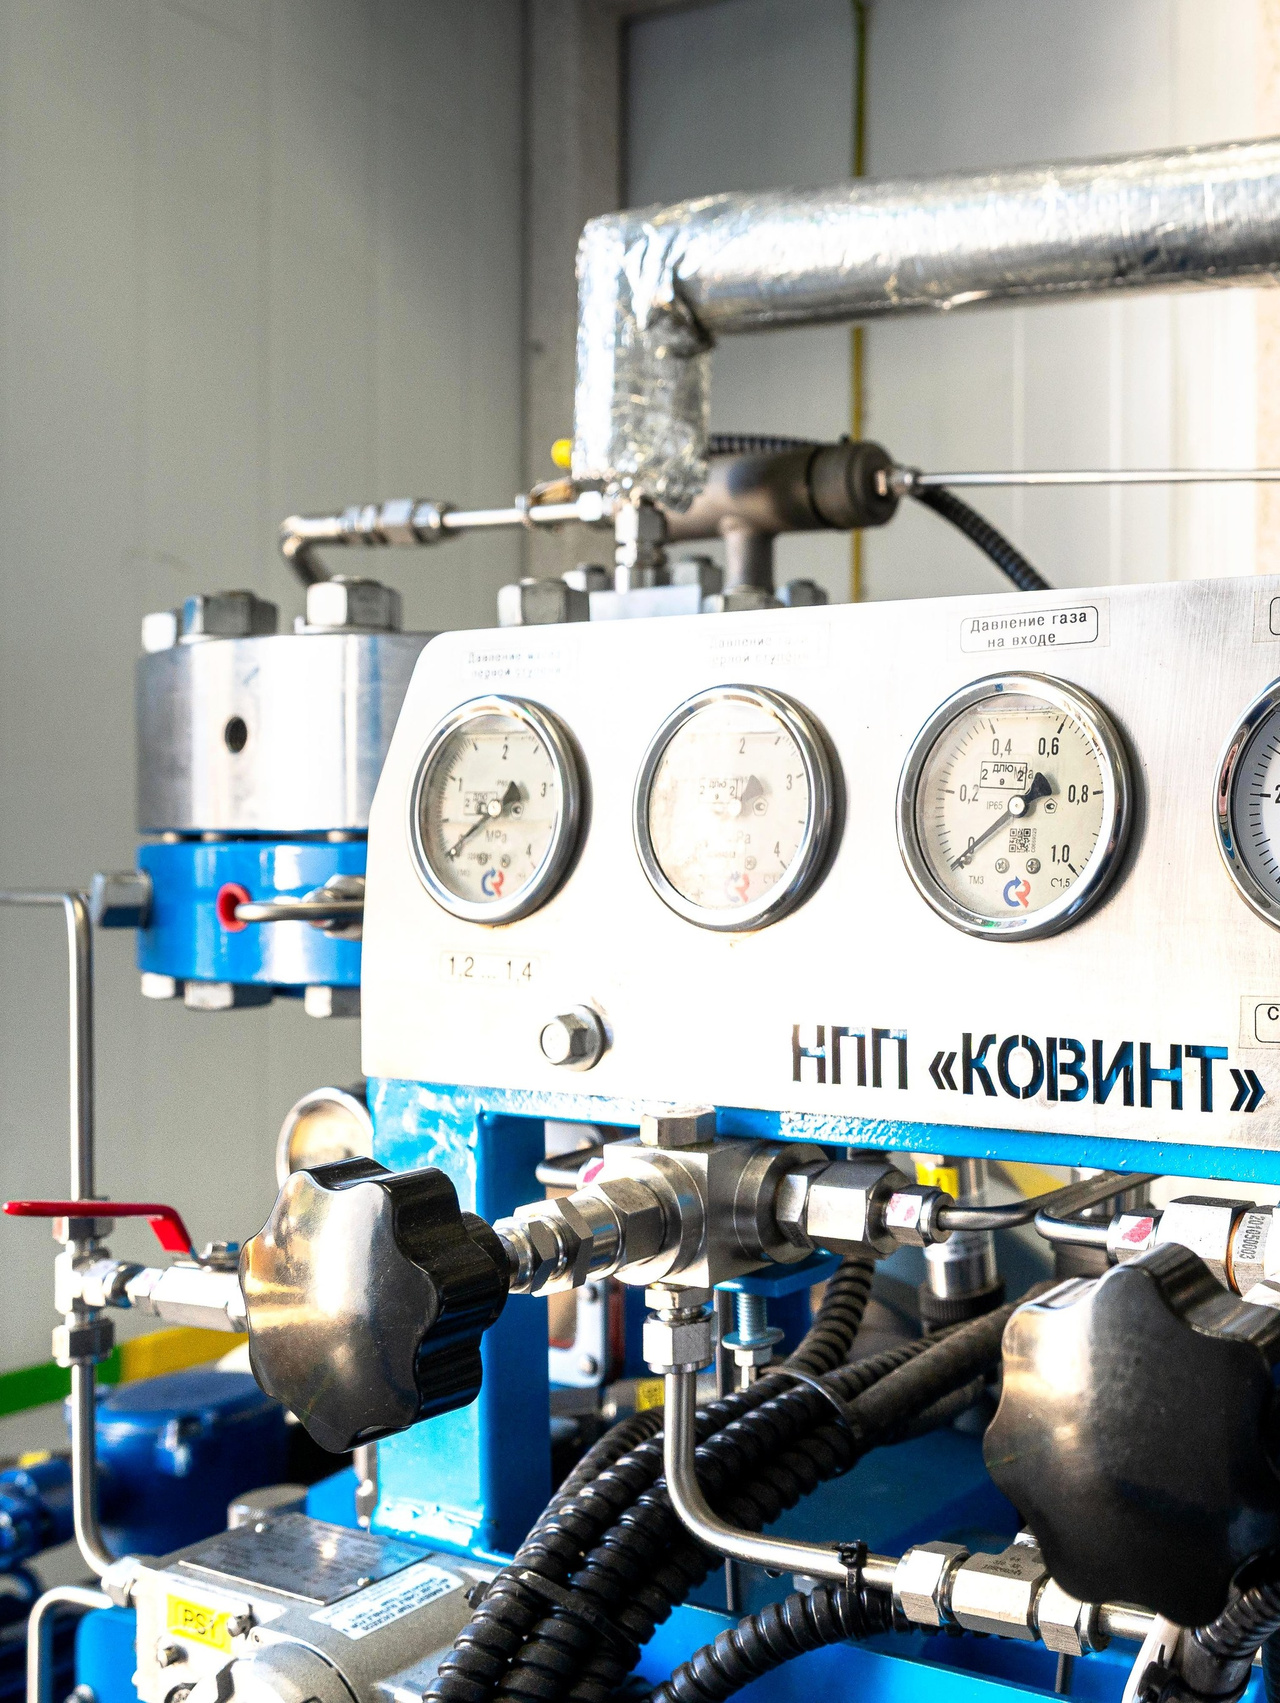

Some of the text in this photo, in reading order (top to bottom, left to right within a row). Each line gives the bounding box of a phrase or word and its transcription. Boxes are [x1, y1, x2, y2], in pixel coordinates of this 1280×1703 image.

[970, 612, 1088, 634] Давление газа
[987, 633, 1056, 648] на входе
[502, 744, 509, 760] 2
[738, 737, 746, 754] 2
[992, 738, 1012, 758] 0,4
[1038, 737, 1059, 758] 0,6
[540, 782, 547, 798] 3
[786, 774, 793, 791] 3
[959, 784, 980, 804] 0,2
[1068, 784, 1089, 805] 0,8
[986, 800, 1003, 810] IP65
[773, 841, 781, 857] 4
[1051, 844, 1070, 865] 1,0
[791, 1024, 1267, 1113] НПП «КОВИНТ»
